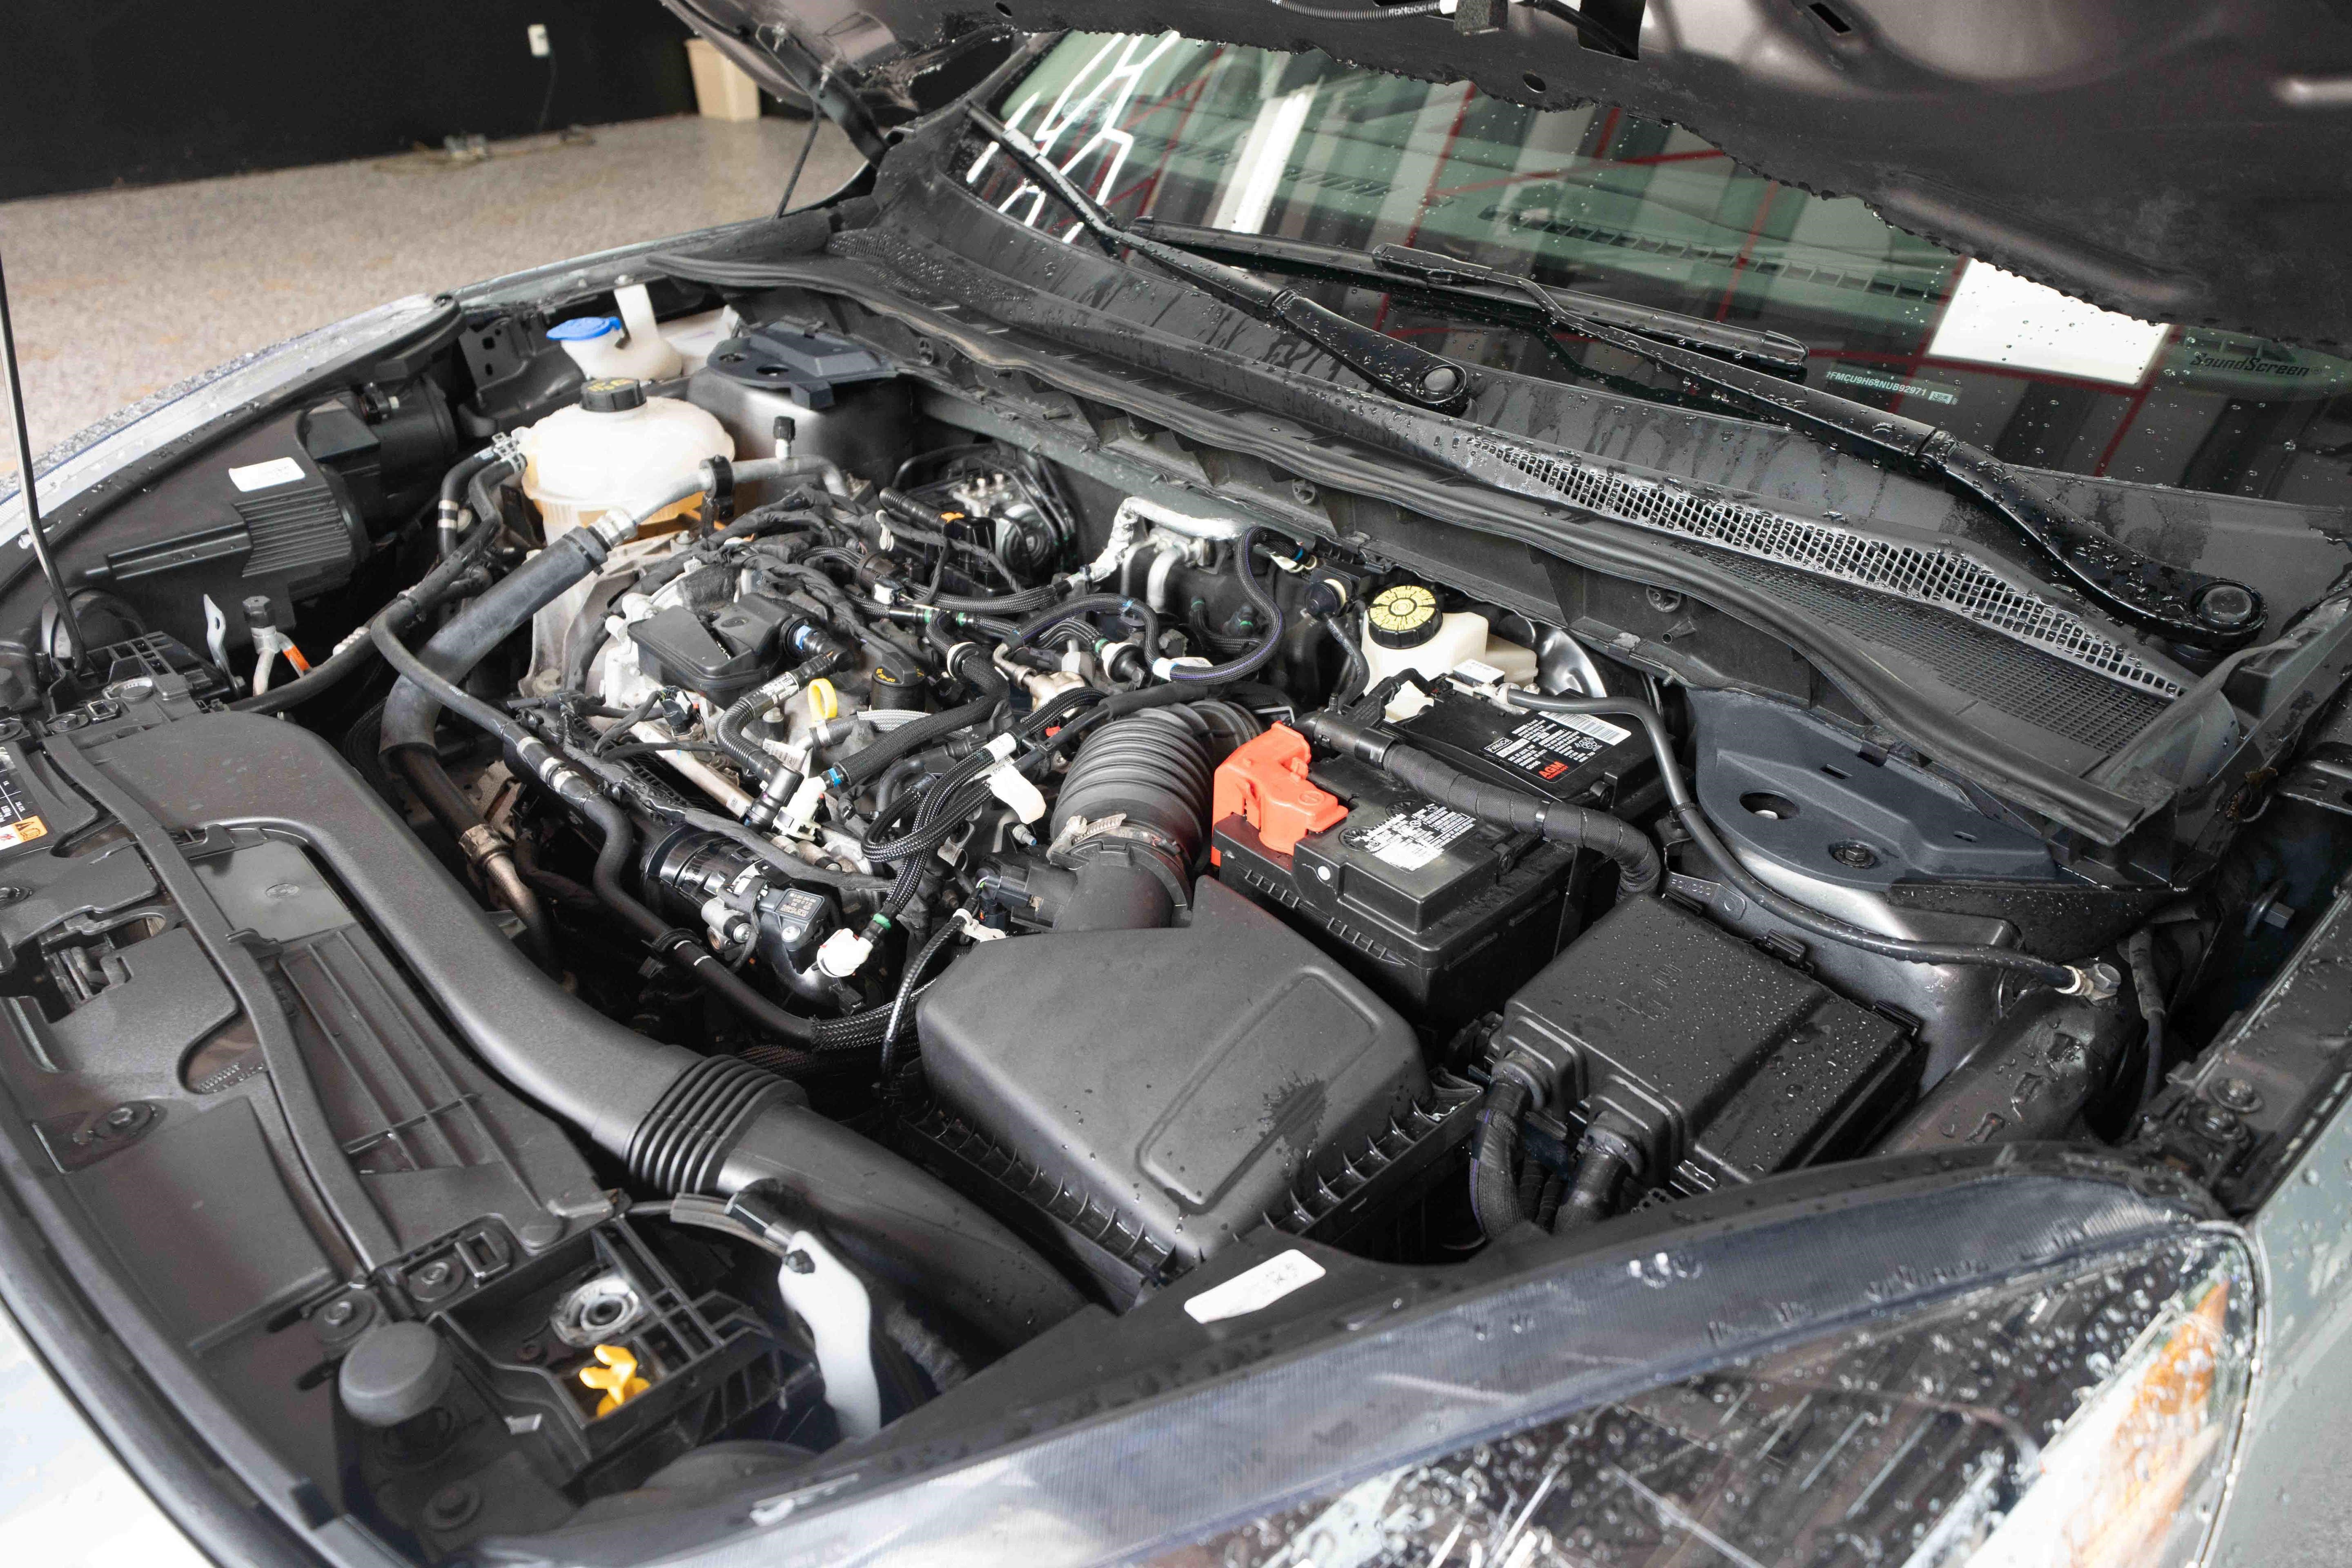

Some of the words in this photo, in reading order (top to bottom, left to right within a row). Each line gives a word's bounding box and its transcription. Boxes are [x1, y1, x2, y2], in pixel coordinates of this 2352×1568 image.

[2190, 353, 2310, 376] SoundScreen
[1488, 738, 1510, 753] FoMoCo
[1539, 761, 1566, 778] AGM
